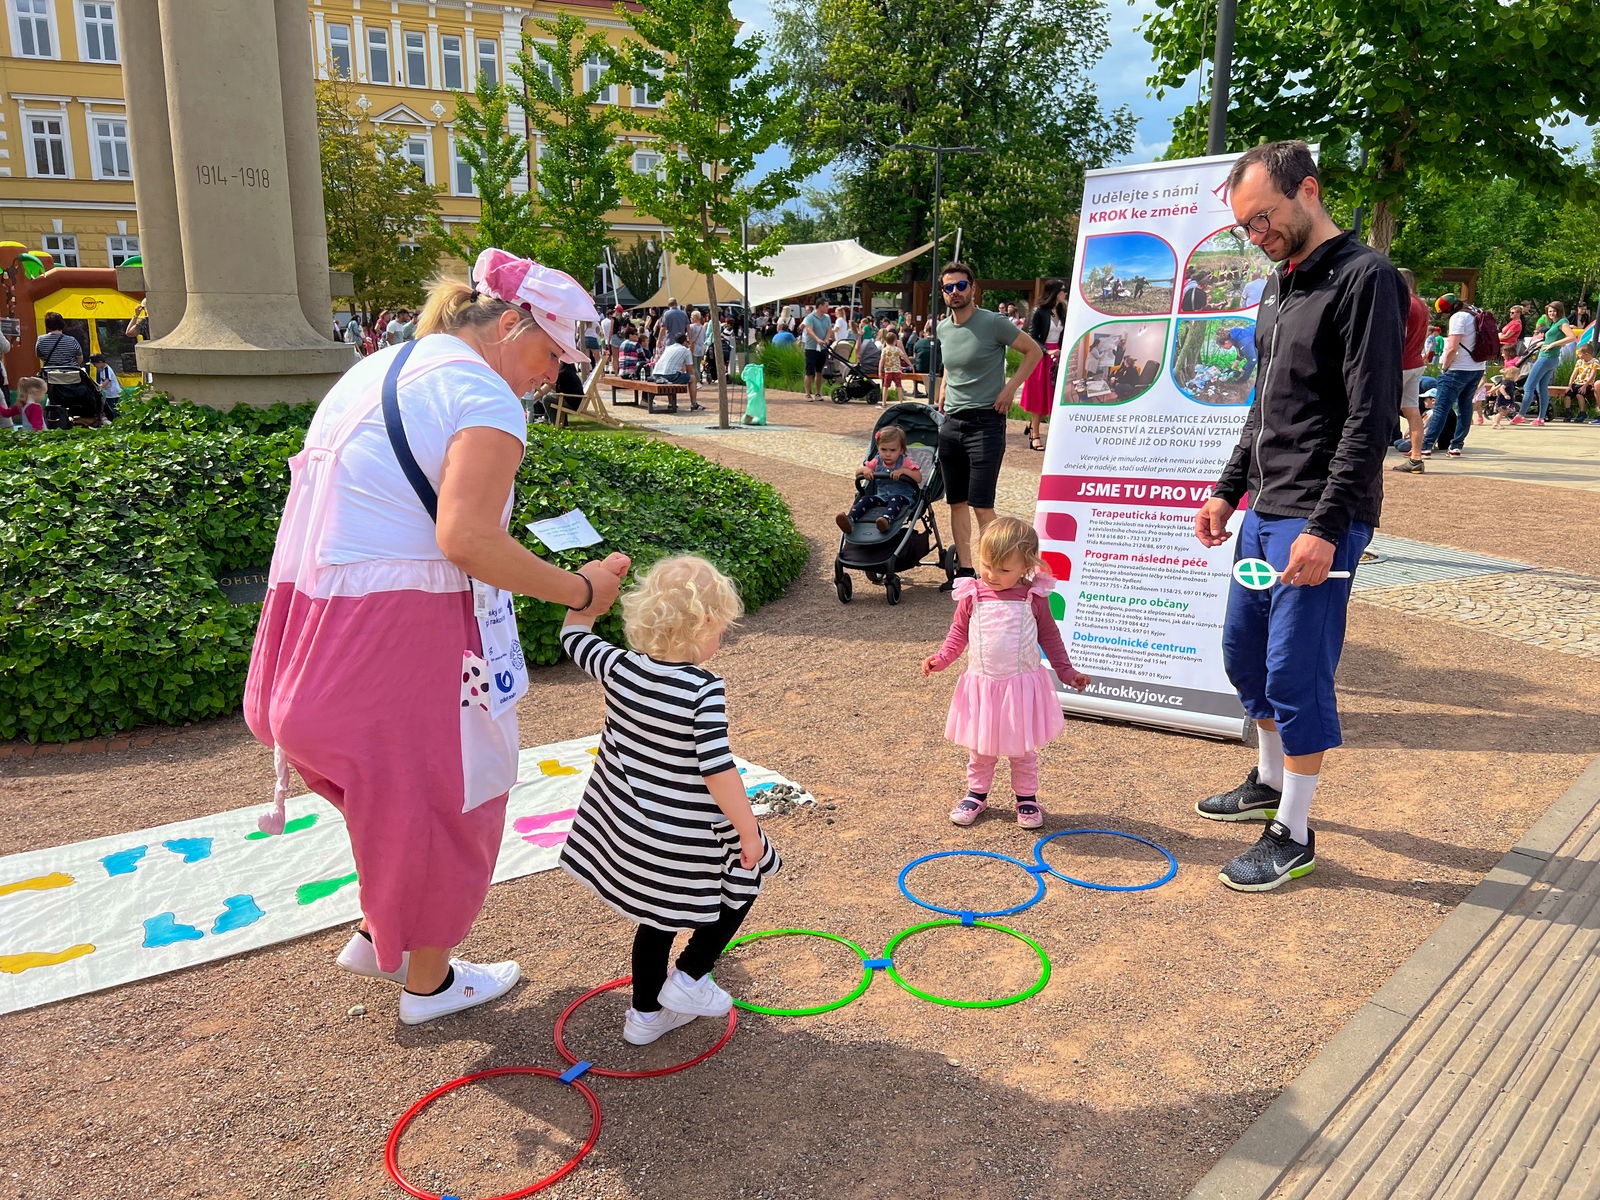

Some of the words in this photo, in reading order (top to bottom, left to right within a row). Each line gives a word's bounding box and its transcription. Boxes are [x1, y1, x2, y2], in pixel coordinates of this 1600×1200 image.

[1092, 188, 1148, 204] Udělejte
[1153, 188, 1159, 198] s
[1162, 183, 1199, 198] námi
[1089, 208, 1128, 223] KROK
[1131, 206, 1147, 219] ke
[1150, 202, 1198, 218] změně
[1069, 413, 1115, 422] VĚNUJEME
[1129, 415, 1199, 423] PROBLEMATICE
[1200, 413, 1247, 423] ZÁVISLOS
[1075, 425, 1138, 433] PORADENSTVÍ
[1148, 426, 1206, 435] ZLEPŠOVÁNÍ
[1138, 437, 1152, 446] JIŽ
[1170, 439, 1196, 447] ROKU
[1077, 482, 1120, 497] JSME
[1124, 484, 1146, 498] TU
[1150, 486, 1186, 500] PRO
[1189, 485, 1213, 502] VÁ
[1091, 508, 1157, 520] Terapeutická
[1085, 550, 1129, 564] Program
[1131, 552, 1180, 566] následné
[1182, 557, 1208, 569] péče
[1079, 590, 1126, 604] Agentura
[1129, 597, 1147, 606] pro
[1150, 598, 1189, 611] občany
[1073, 631, 1148, 649] Dobrovolnické
[1151, 642, 1196, 654] centrum
[1082, 664, 1114, 672] Komenského
[1062, 682, 1183, 706] ww.krokkyjov.cz
